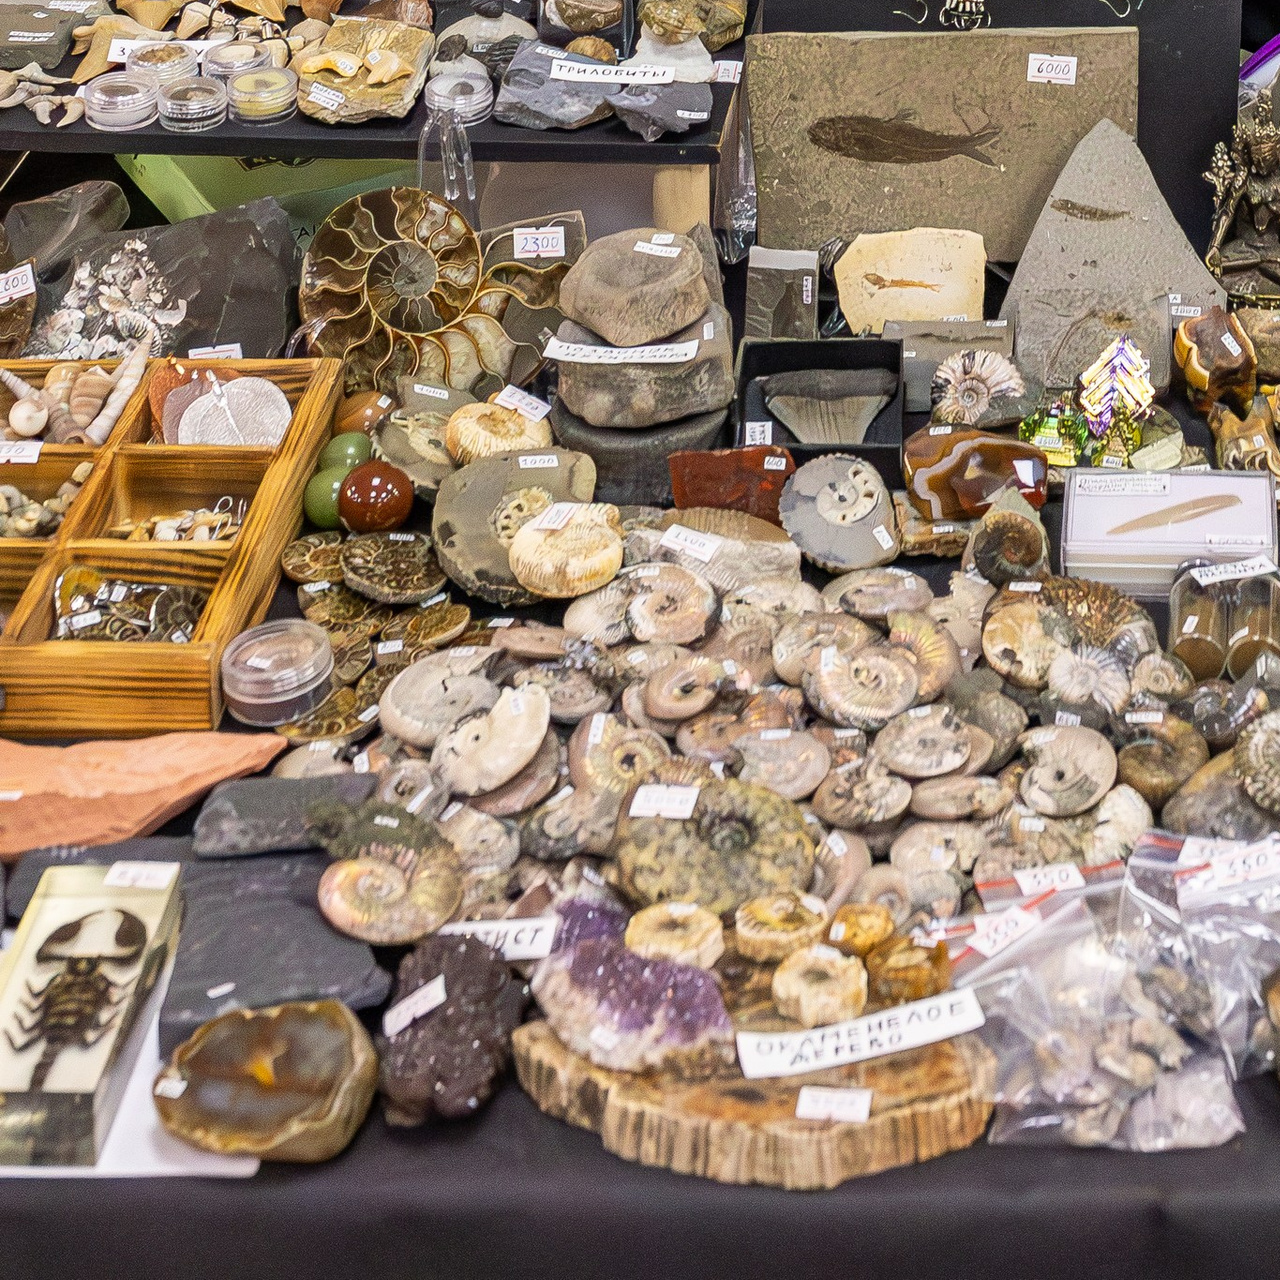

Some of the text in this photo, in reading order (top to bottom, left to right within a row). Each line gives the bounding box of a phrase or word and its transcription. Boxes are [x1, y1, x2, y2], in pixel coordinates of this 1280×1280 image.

[555, 63, 667, 78] ТРИЛОБИТЫ
[1037, 61, 1070, 76] 6000
[521, 236, 559, 253] 2300
[521, 458, 555, 466] 1000
[756, 999, 967, 1056] ОКАМЕНЕЛОЕ
